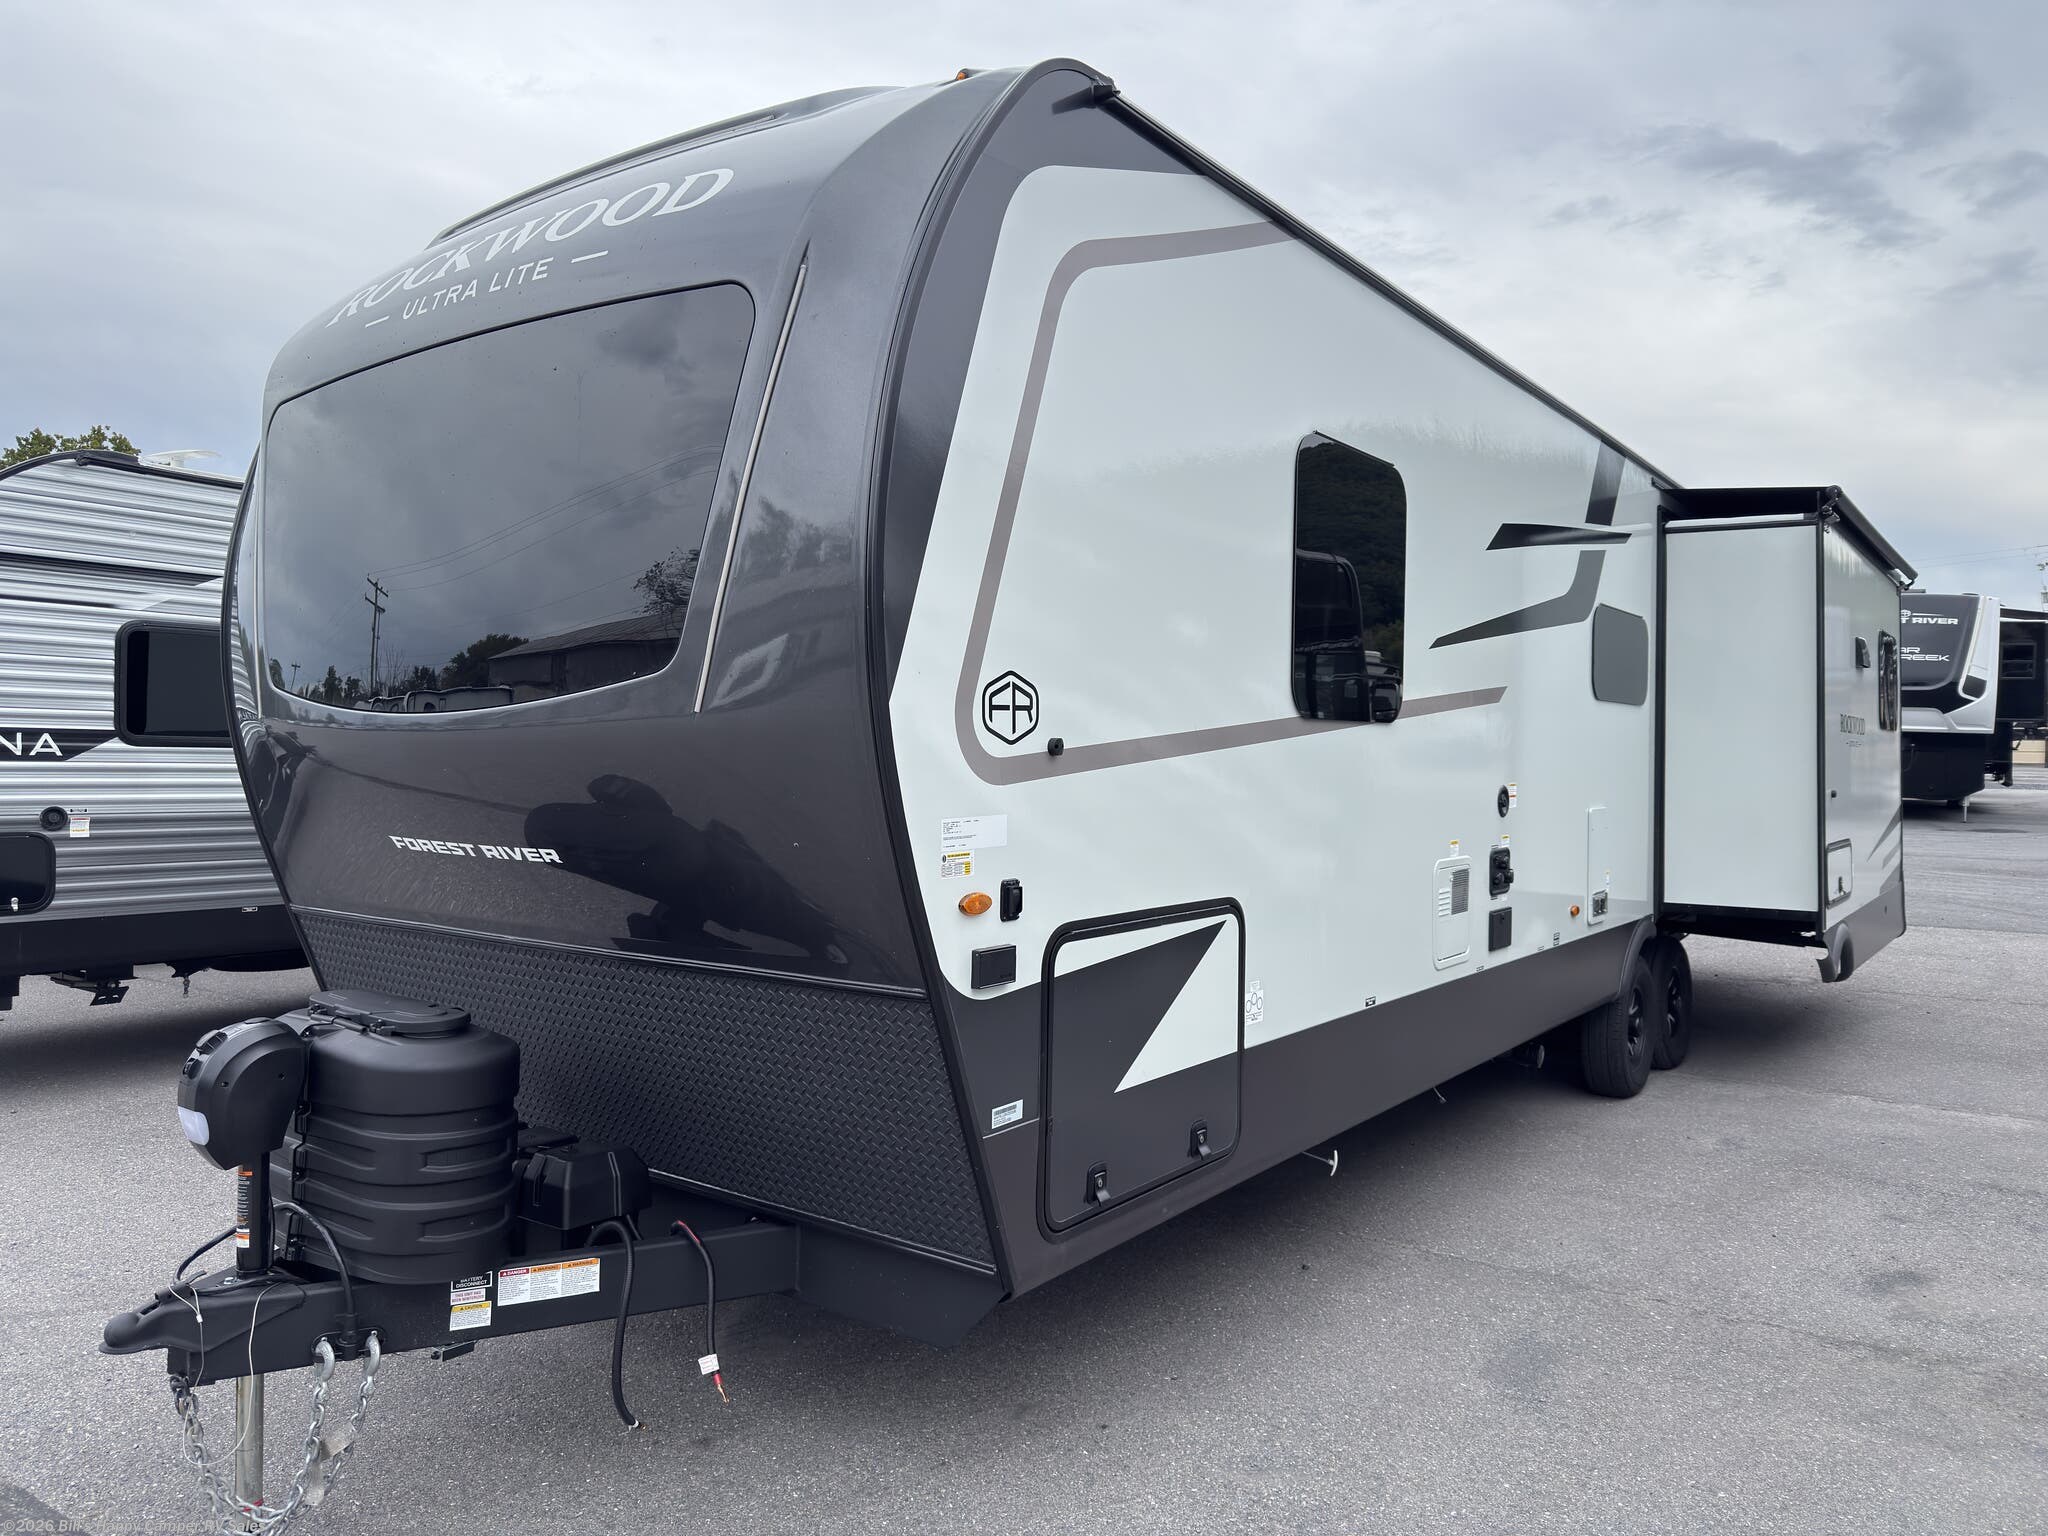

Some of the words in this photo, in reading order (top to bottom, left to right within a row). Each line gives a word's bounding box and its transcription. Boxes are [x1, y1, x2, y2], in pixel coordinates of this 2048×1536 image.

[325, 168, 734, 328] ROCKWOOD
[402, 279, 478, 320] ULTRA
[488, 257, 555, 293] LITE
[1911, 617, 1959, 625] RIVER
[388, 835, 477, 857] FOREST
[478, 844, 564, 864] RIVER
[455, 1279, 488, 1289] DISCONNECT
[460, 1275, 484, 1283] BATTERY
